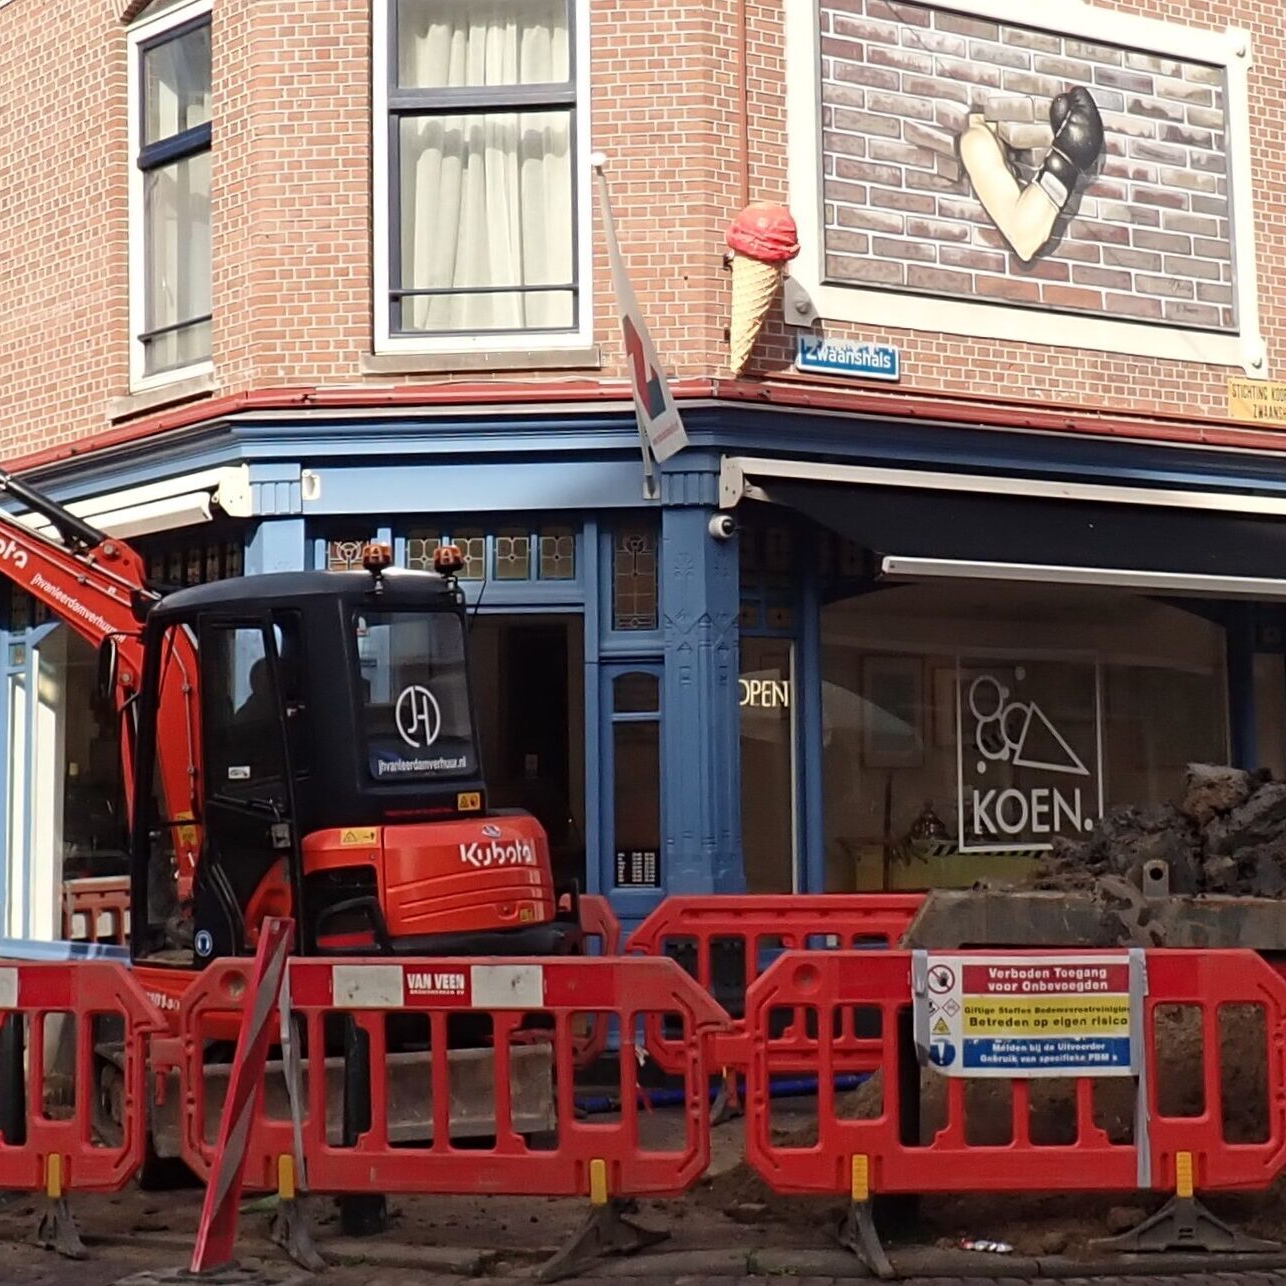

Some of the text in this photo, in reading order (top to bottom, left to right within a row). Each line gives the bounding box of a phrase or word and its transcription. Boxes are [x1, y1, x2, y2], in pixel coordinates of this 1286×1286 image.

[805, 345, 892, 369] Zwaanshals
[973, 787, 1094, 834] KOEN.
[459, 839, 533, 866] Kubota
[988, 967, 1107, 980] Verboden Toegang
[406, 973, 465, 989] VAN VEEN
[987, 981, 1108, 992] voor Onbevoegden
[964, 1005, 996, 1015] Giftige
[969, 1016, 1128, 1028] Betreden op eigen risico
